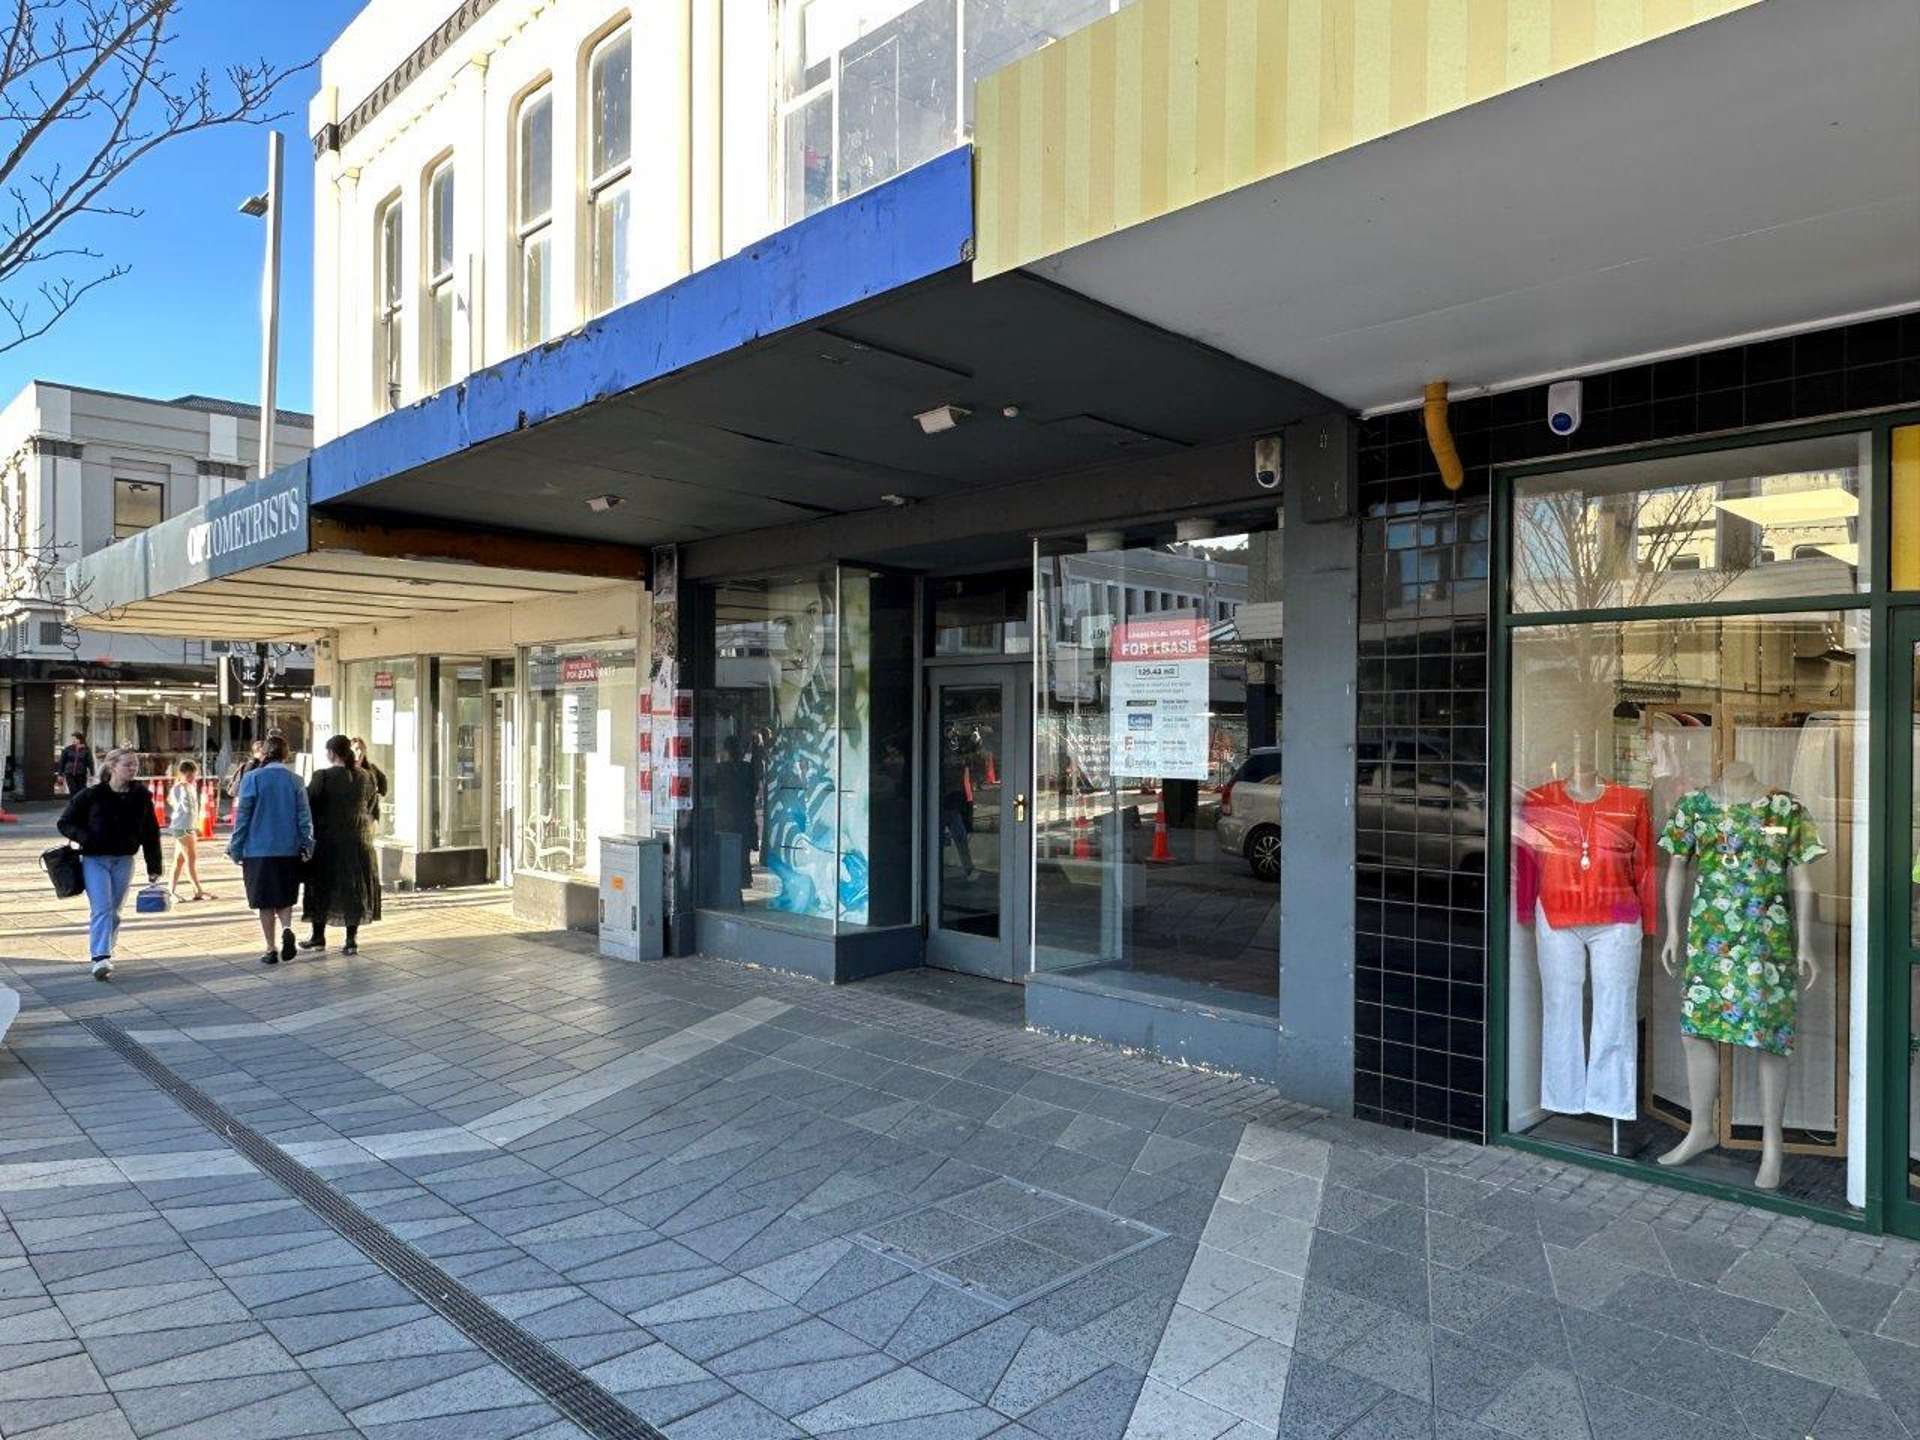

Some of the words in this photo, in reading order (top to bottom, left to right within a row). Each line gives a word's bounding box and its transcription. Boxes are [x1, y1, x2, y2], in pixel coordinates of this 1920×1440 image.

[187, 488, 300, 566] OPTOMETRISTS
[1121, 642, 1149, 656] FOR
[1152, 639, 1198, 655] LEASE
